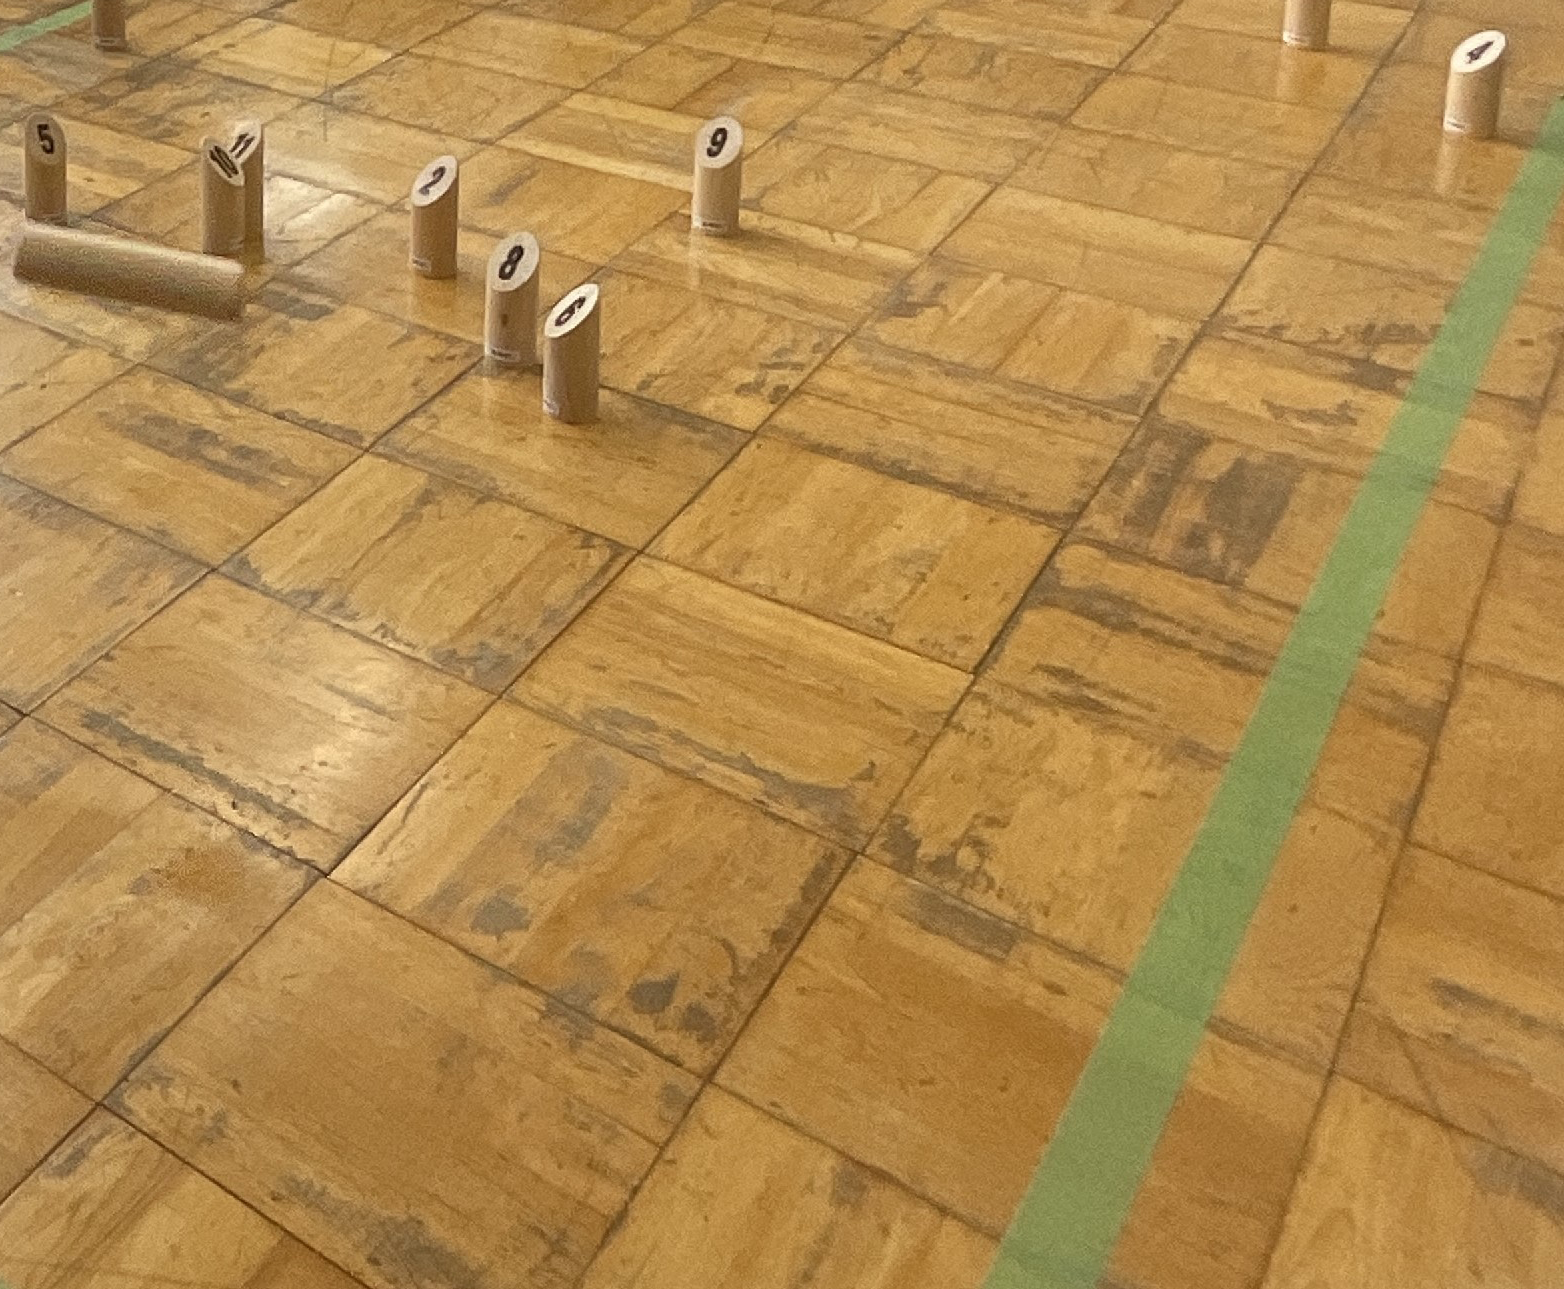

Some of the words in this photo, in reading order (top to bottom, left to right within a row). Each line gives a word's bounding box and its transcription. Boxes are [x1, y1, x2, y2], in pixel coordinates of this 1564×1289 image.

[36, 123, 55, 155] 5
[706, 127, 728, 158] 9
[418, 165, 447, 196] 2
[498, 244, 525, 281] 8
[554, 295, 587, 328] 6
